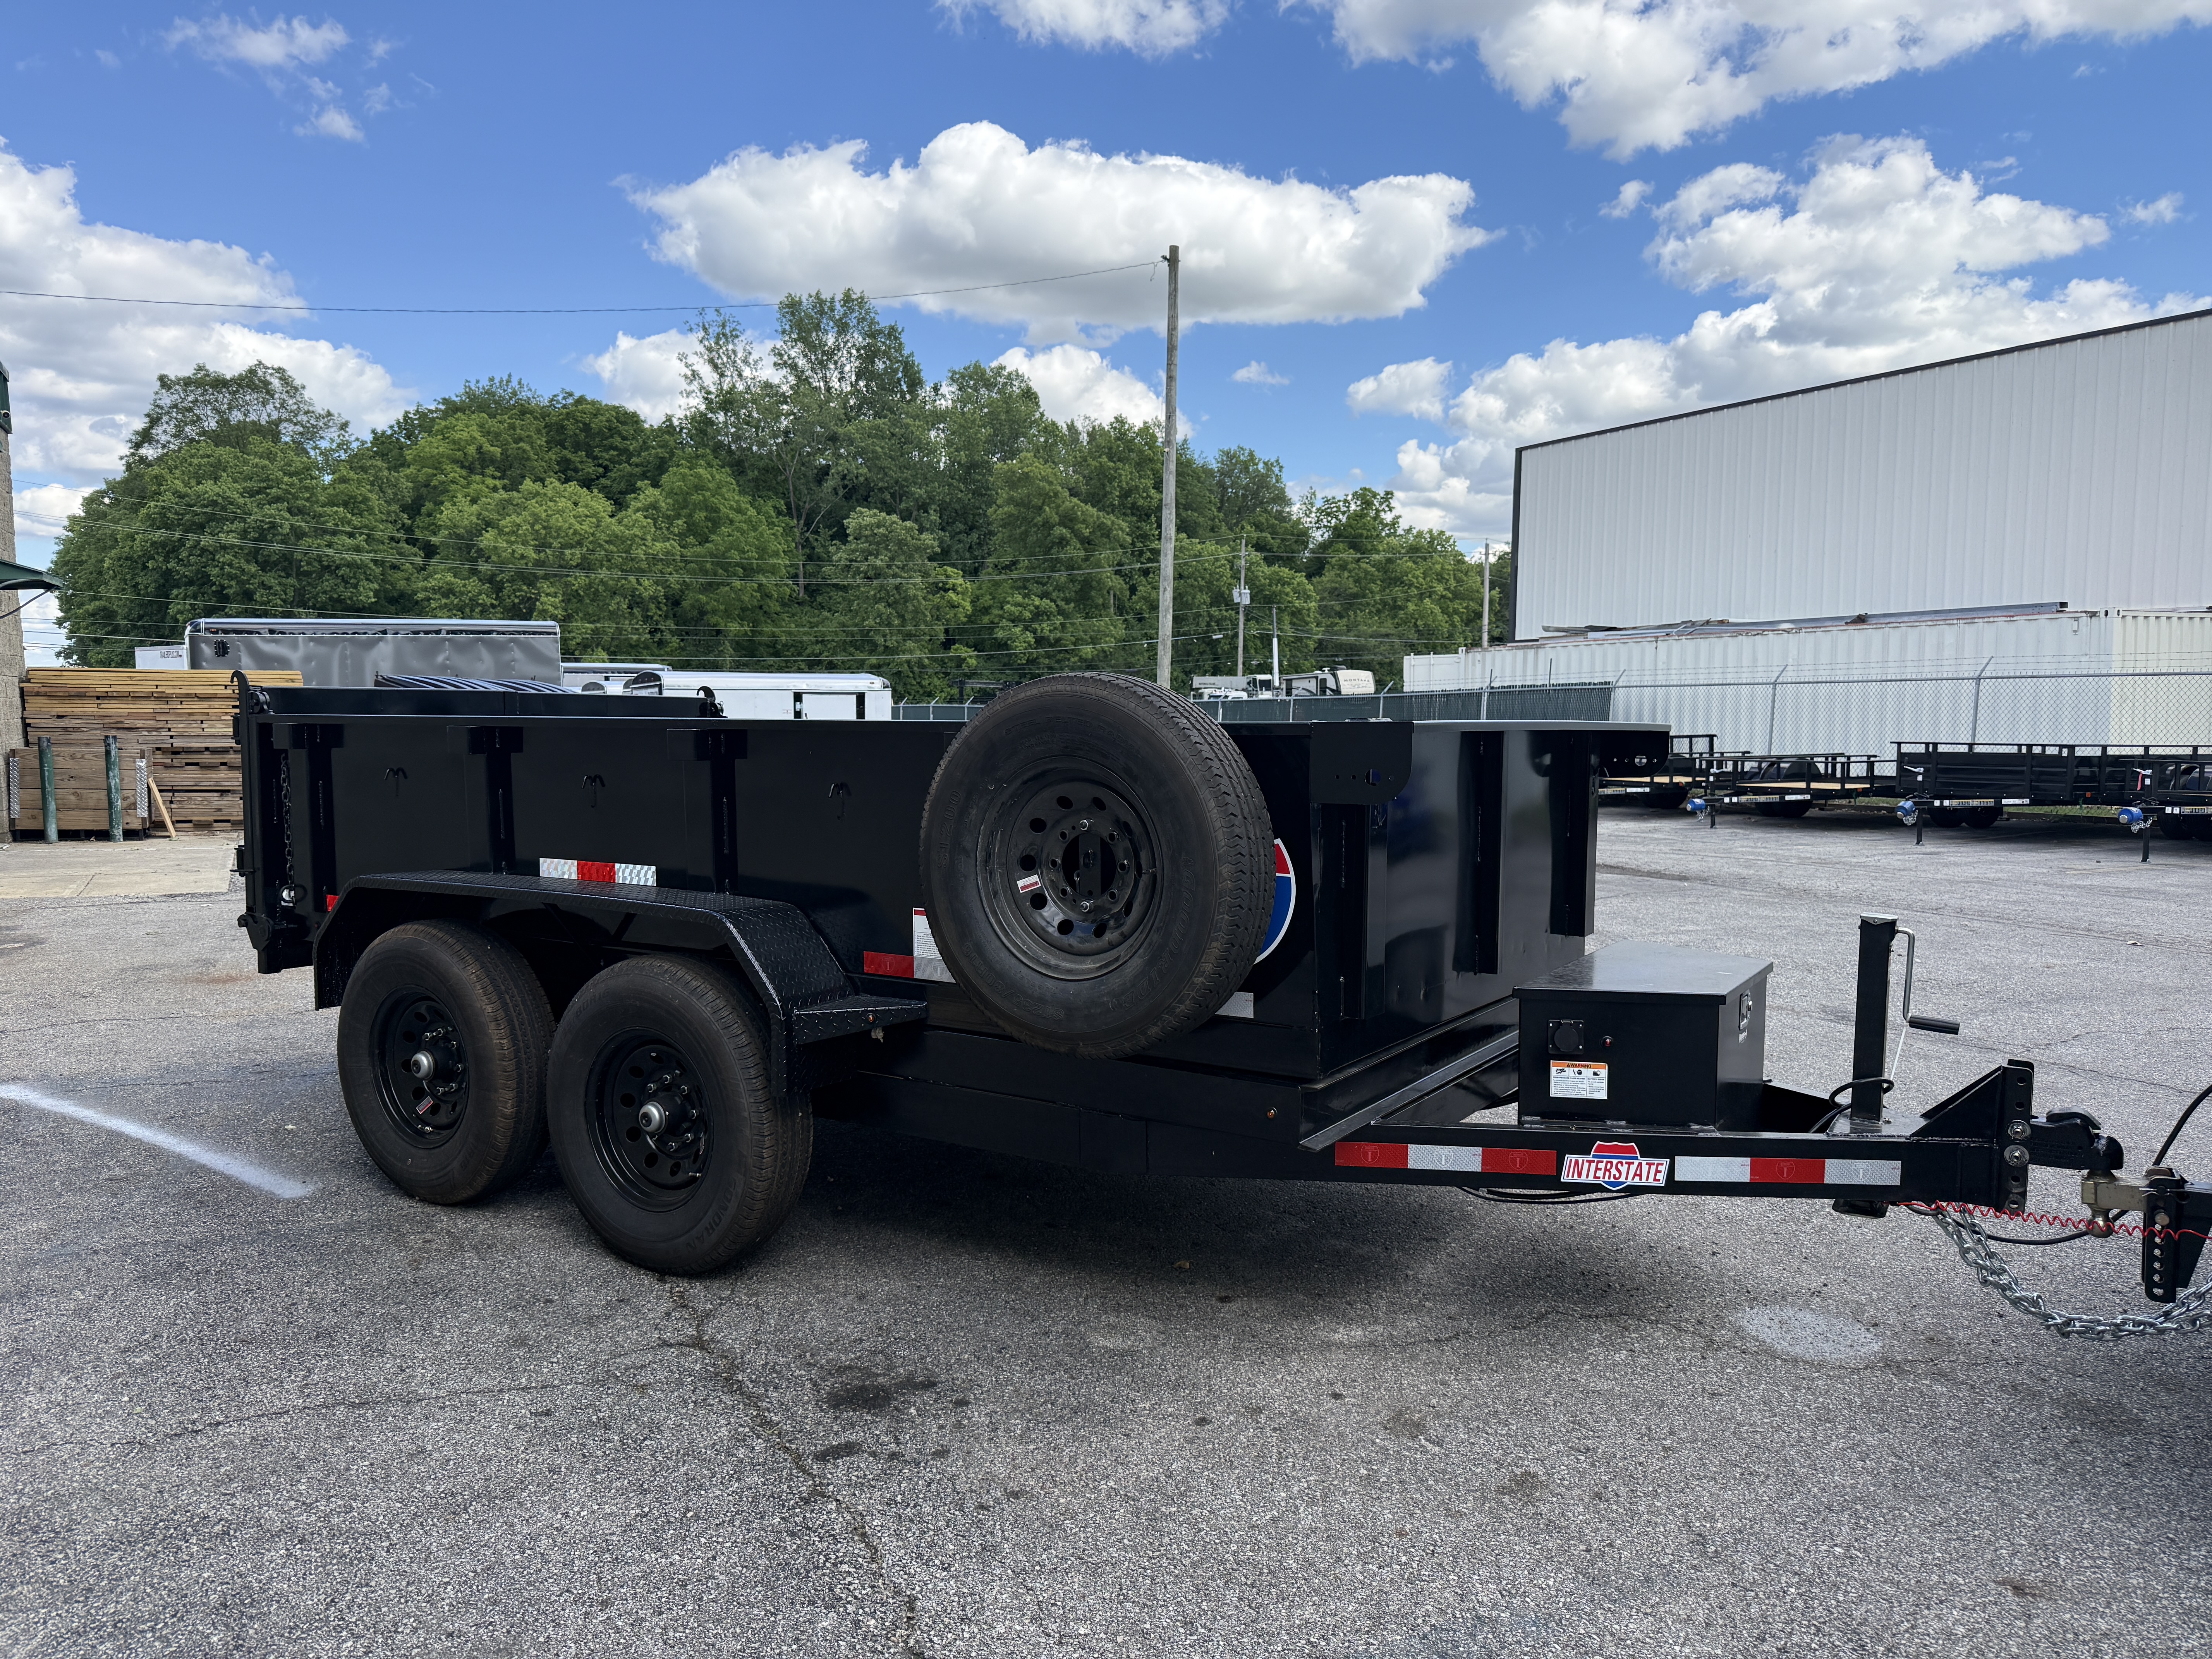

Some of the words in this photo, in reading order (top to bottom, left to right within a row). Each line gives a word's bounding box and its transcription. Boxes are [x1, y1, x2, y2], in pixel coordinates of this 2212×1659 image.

[1004, 718, 1041, 736] STEEL
[1045, 716, 1093, 728] BELTED
[1123, 869, 1196, 1011] GOODRIDE
[962, 943, 1065, 1021] ST235/80R16
[1566, 1158, 1664, 1182] INTERSTATE
